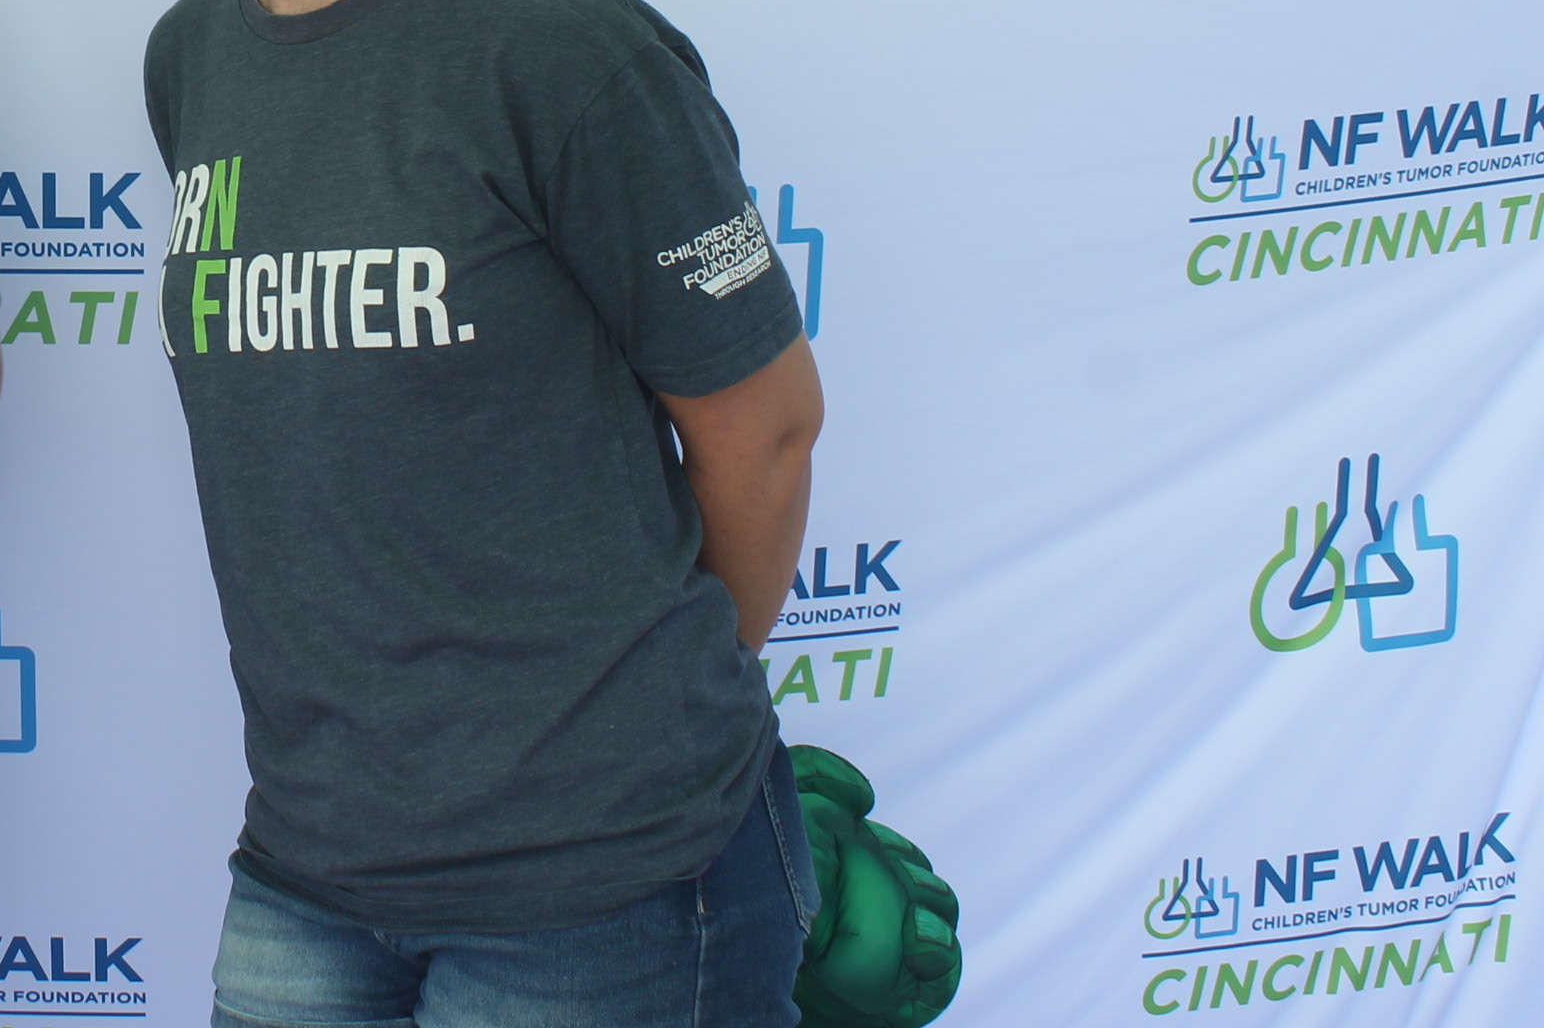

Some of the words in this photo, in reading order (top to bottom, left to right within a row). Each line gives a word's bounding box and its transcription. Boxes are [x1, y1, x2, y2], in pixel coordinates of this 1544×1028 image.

[1299, 112, 1384, 171] NF
[1295, 172, 1391, 196] CHILDREN'S
[1397, 165, 1451, 184] TUMOR
[1, 242, 145, 257] FOUNDATION
[657, 216, 742, 267] CHILDREN'S
[682, 232, 766, 290] FOUNDATION
[697, 230, 747, 265] TUMOR
[192, 246, 474, 354] FIGHTER.
[1254, 849, 1339, 908] NF
[1353, 812, 1516, 892] WALK
[1251, 906, 1352, 932] CHILDREN'S
[1357, 898, 1419, 917] TUMOR
[1142, 913, 1511, 1015] CINCINNATI
[13, 990, 146, 1005] FOUNDATION
